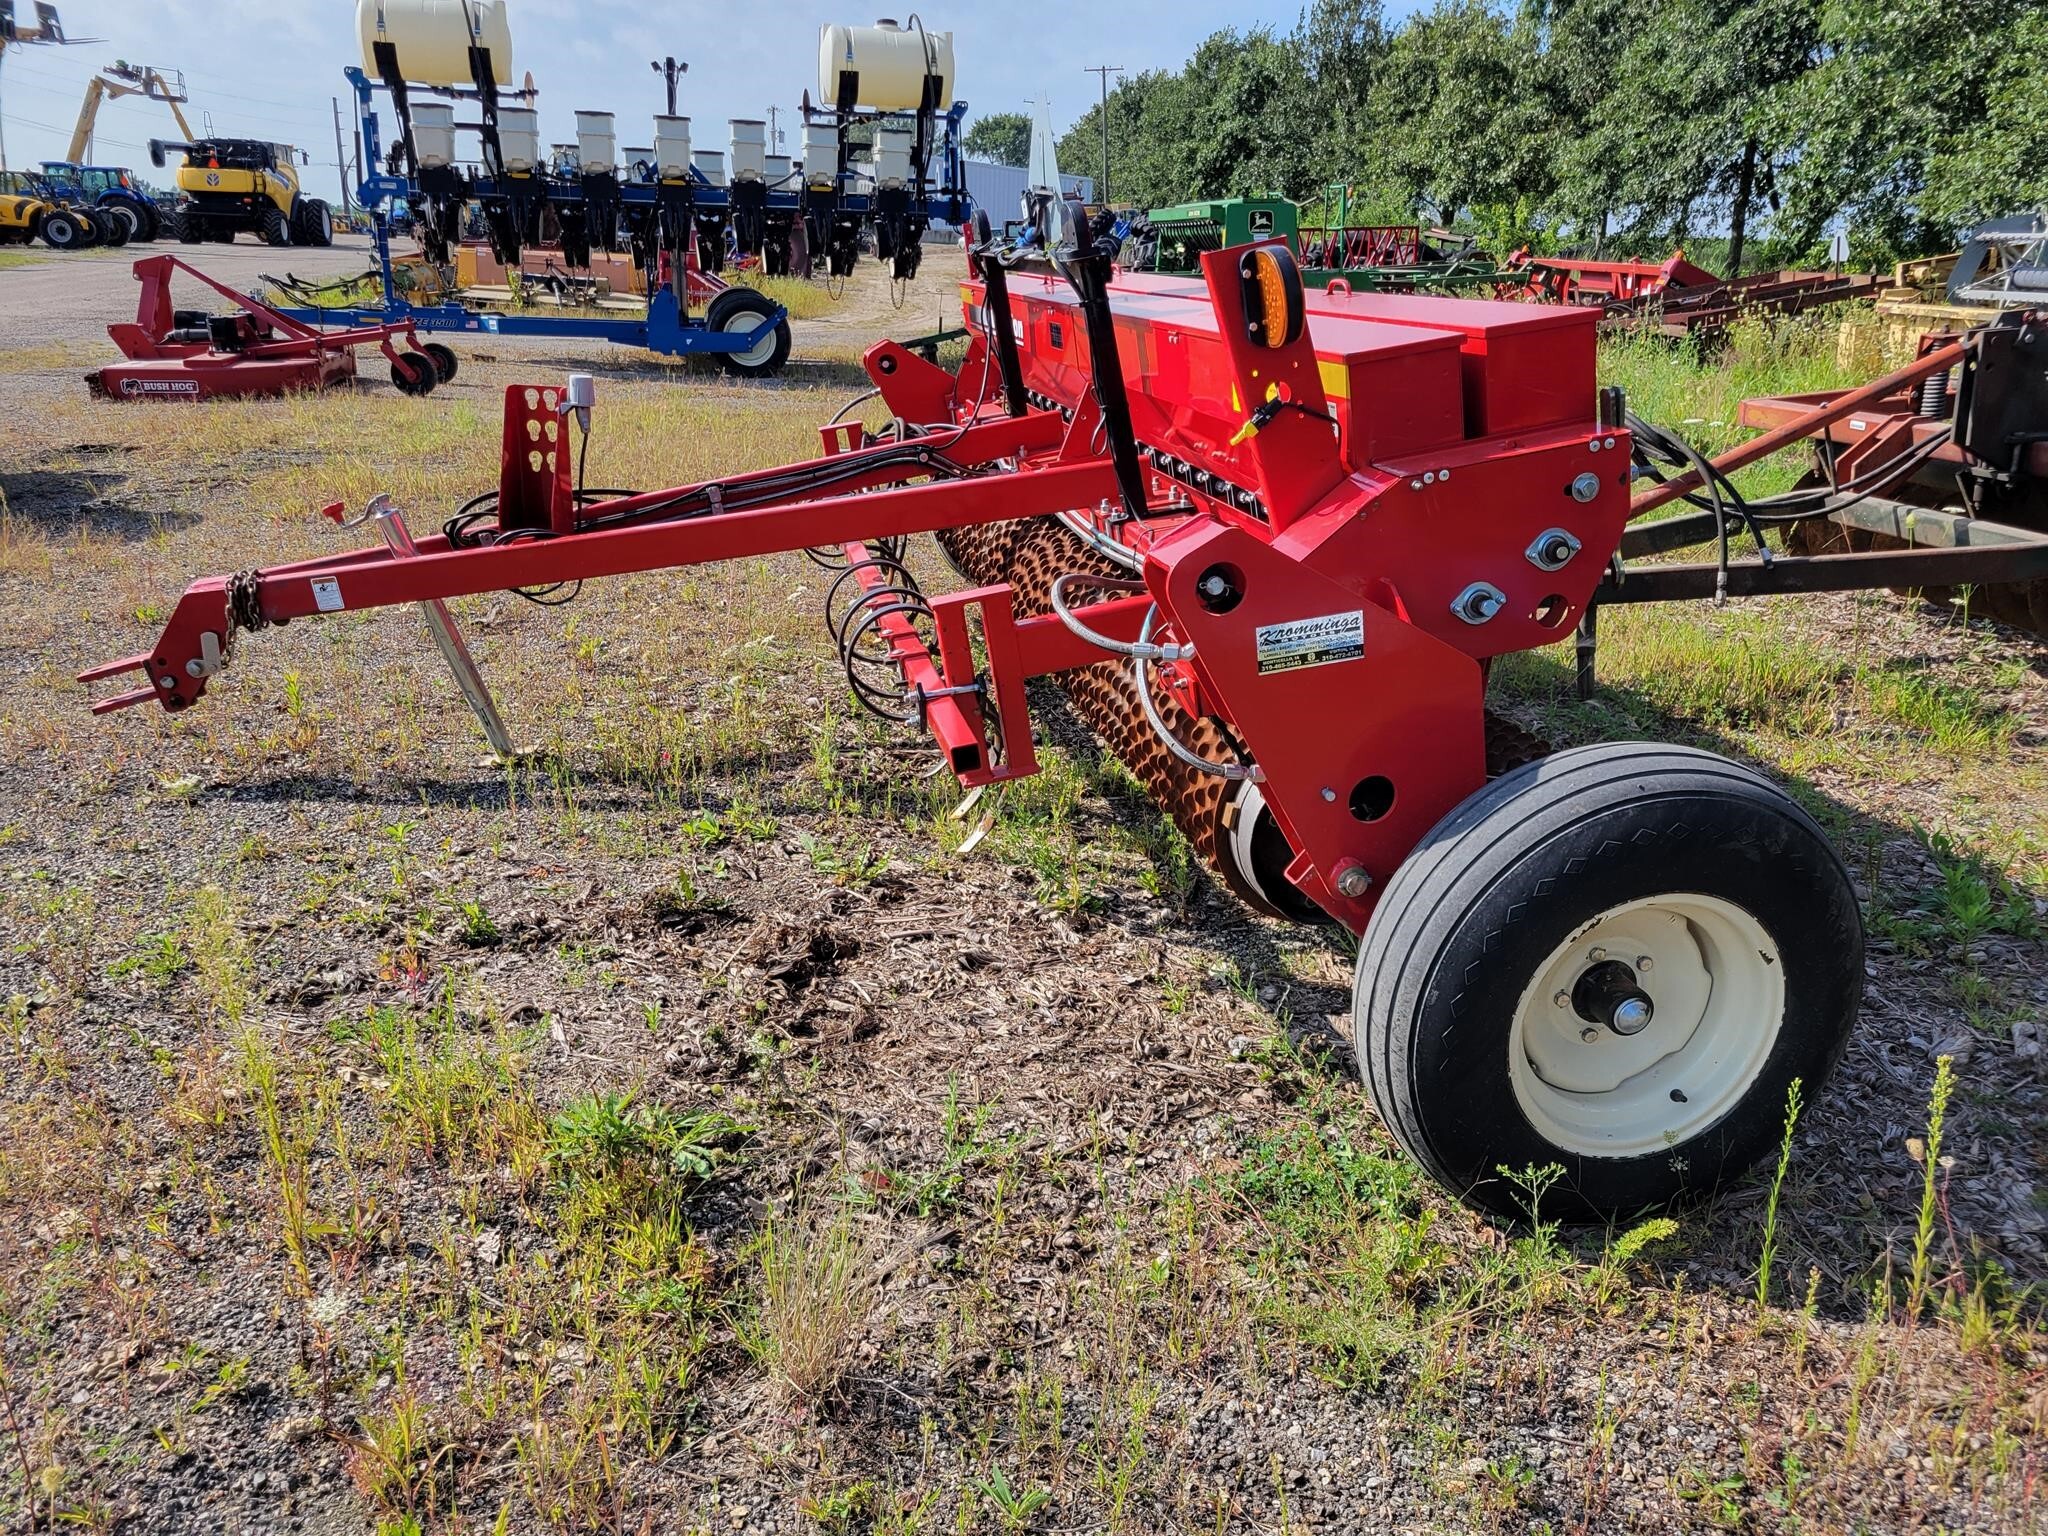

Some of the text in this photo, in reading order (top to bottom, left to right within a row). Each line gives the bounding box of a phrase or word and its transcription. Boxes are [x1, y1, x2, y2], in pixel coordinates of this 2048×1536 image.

[143, 382, 194, 391] BUSH HOG
[1259, 616, 1360, 647] Kromminga
[1281, 630, 1336, 644] MOTORS
